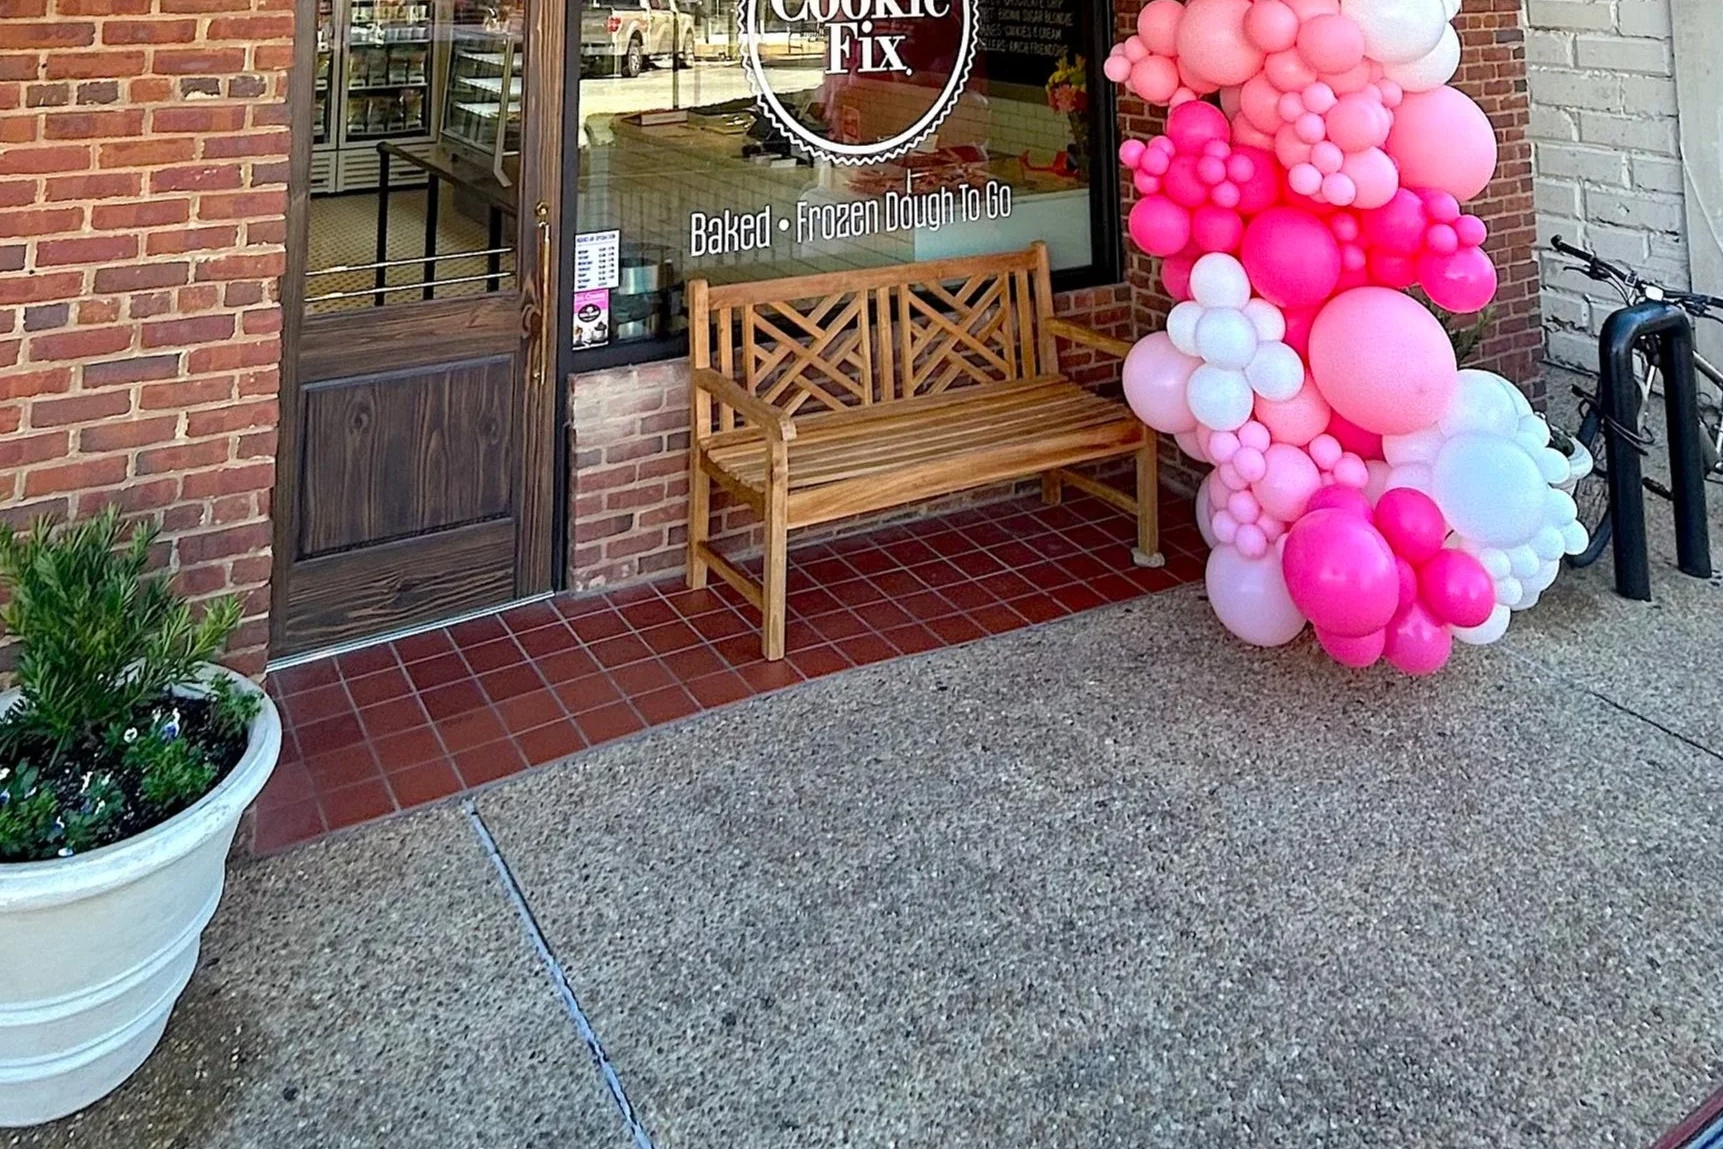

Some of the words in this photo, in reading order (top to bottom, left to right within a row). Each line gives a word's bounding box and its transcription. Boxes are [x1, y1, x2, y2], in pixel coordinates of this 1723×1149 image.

[690, 205, 771, 257] Baked
[796, 199, 879, 243] Frozen
[885, 186, 954, 232] Dough
[958, 183, 981, 222] To
[985, 181, 1012, 219] Go
